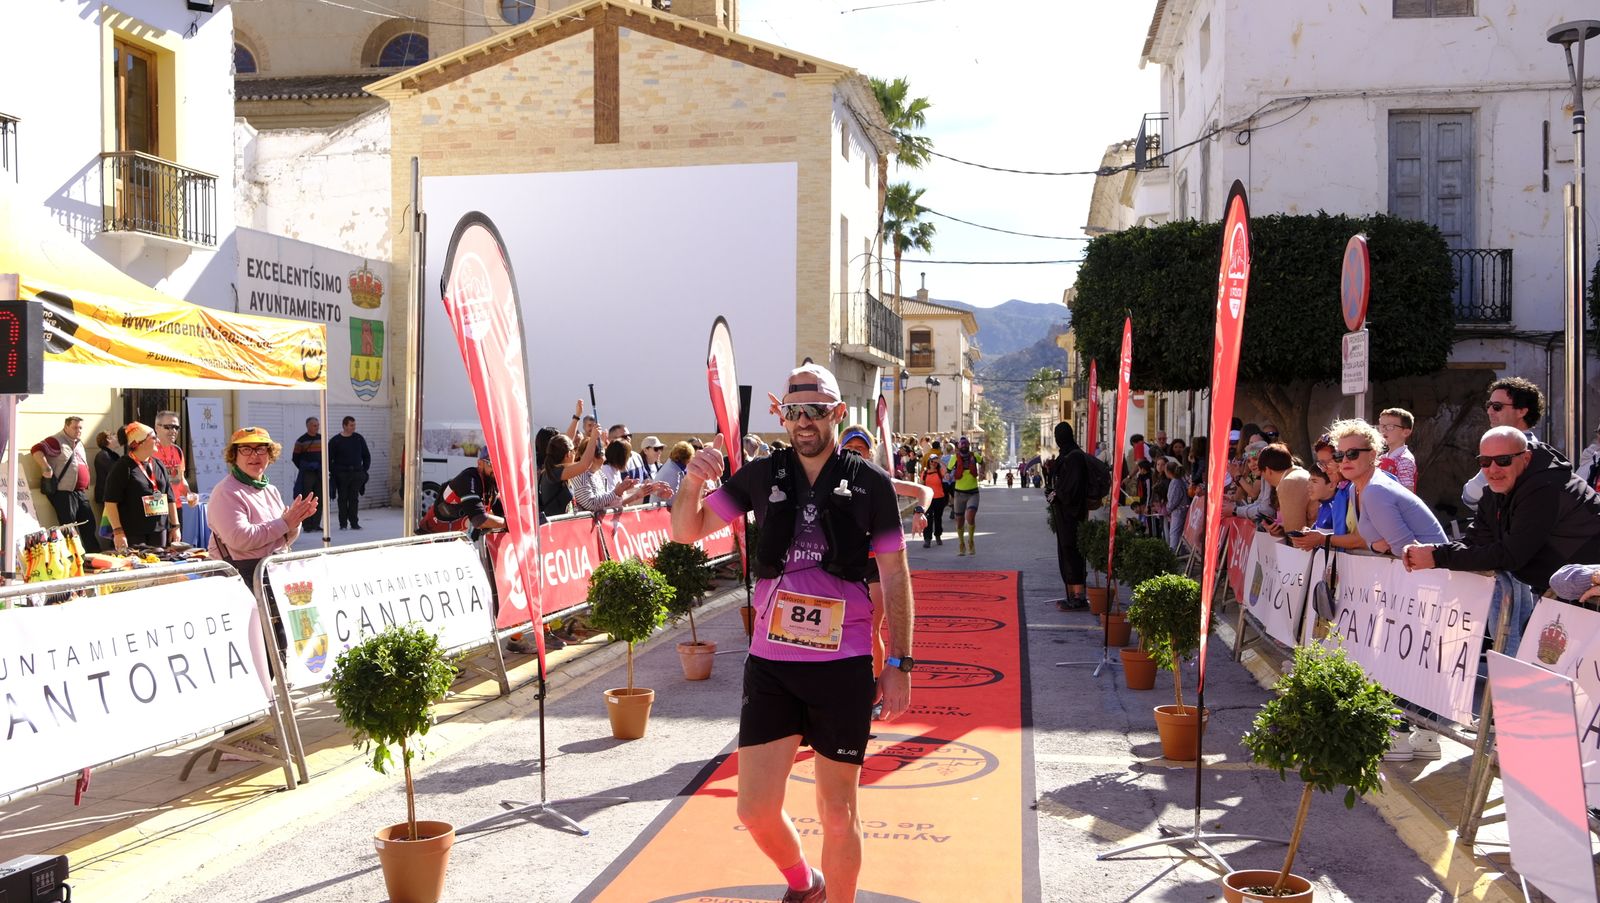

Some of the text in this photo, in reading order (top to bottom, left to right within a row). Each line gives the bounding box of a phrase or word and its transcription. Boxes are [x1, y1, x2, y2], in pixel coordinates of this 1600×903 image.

[247, 257, 342, 294] EXCELENTÍSIMO
[249, 290, 341, 322] AYUNTAMIENTO
[332, 566, 473, 602] AYUNTAMIENTO DE
[205, 613, 233, 635] DE
[336, 585, 484, 642] CANTORIA
[791, 605, 821, 626] 84
[1447, 608, 1472, 632] DE
[1336, 607, 1469, 682] CANTORIA
[898, 822, 935, 831] de
